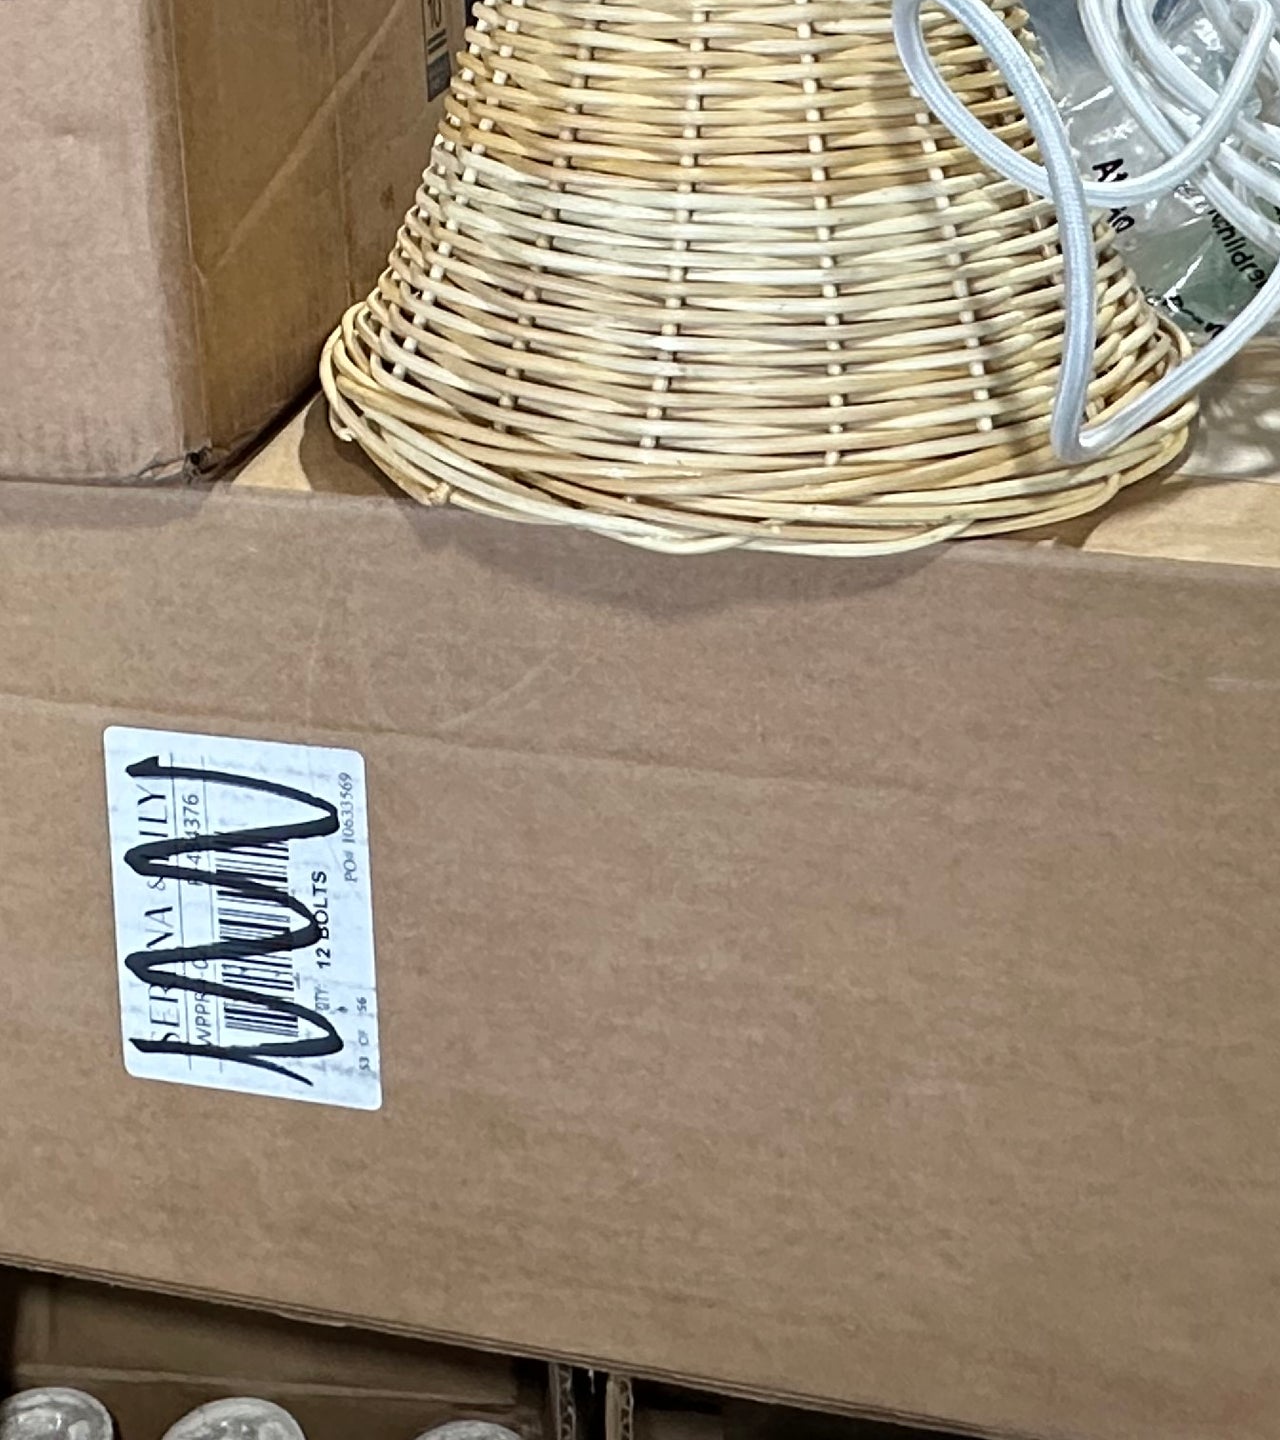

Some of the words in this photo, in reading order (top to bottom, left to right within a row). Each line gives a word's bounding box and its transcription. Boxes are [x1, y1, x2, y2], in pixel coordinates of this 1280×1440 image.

[135, 783, 170, 862] ILY
[181, 793, 205, 888] 44376
[337, 771, 356, 845] 10633569
[311, 870, 332, 942] BOLTS
[143, 906, 181, 1047] SERNA
[315, 947, 332, 970] 12
